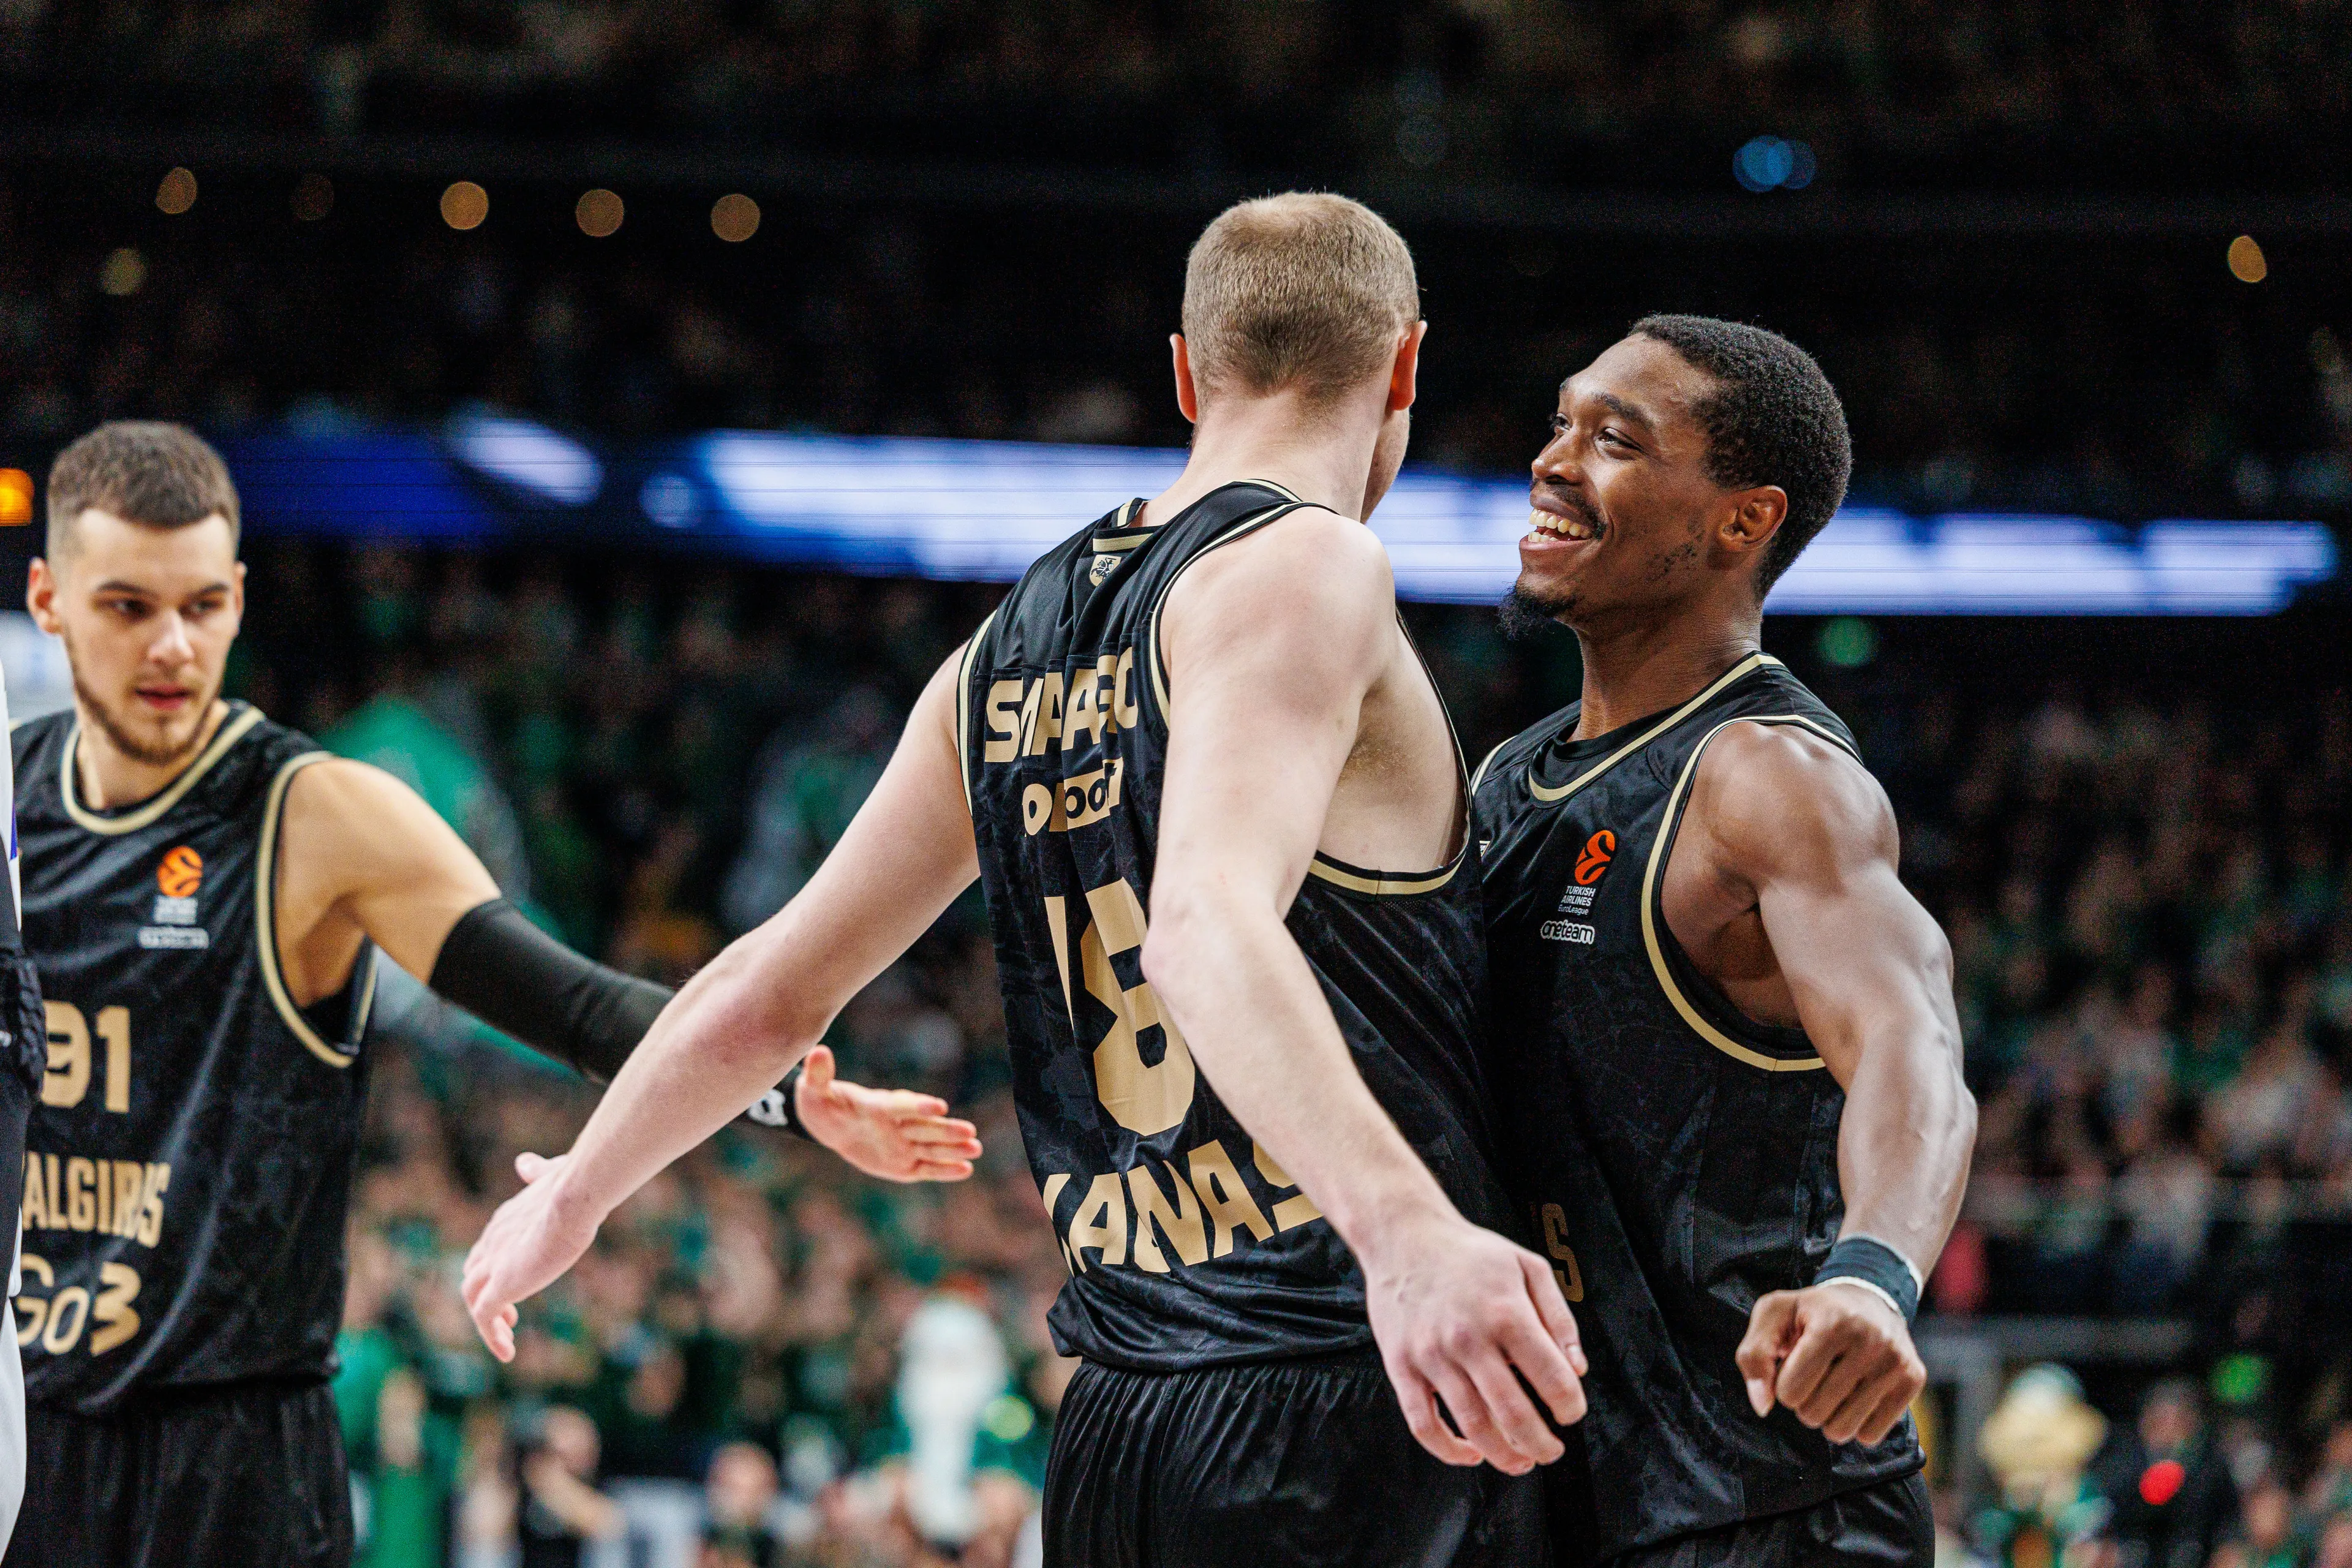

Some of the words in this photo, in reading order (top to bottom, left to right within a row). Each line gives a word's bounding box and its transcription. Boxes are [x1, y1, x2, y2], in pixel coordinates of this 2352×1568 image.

[1566, 886, 1596, 897] TURKISH
[1558, 904, 1589, 916] EuroLeague
[1561, 895, 1593, 907] AIRLINES
[1540, 919, 1595, 944] oneteam
[40, 998, 131, 1113] 91
[21, 1151, 172, 1248] ALGIRIS
